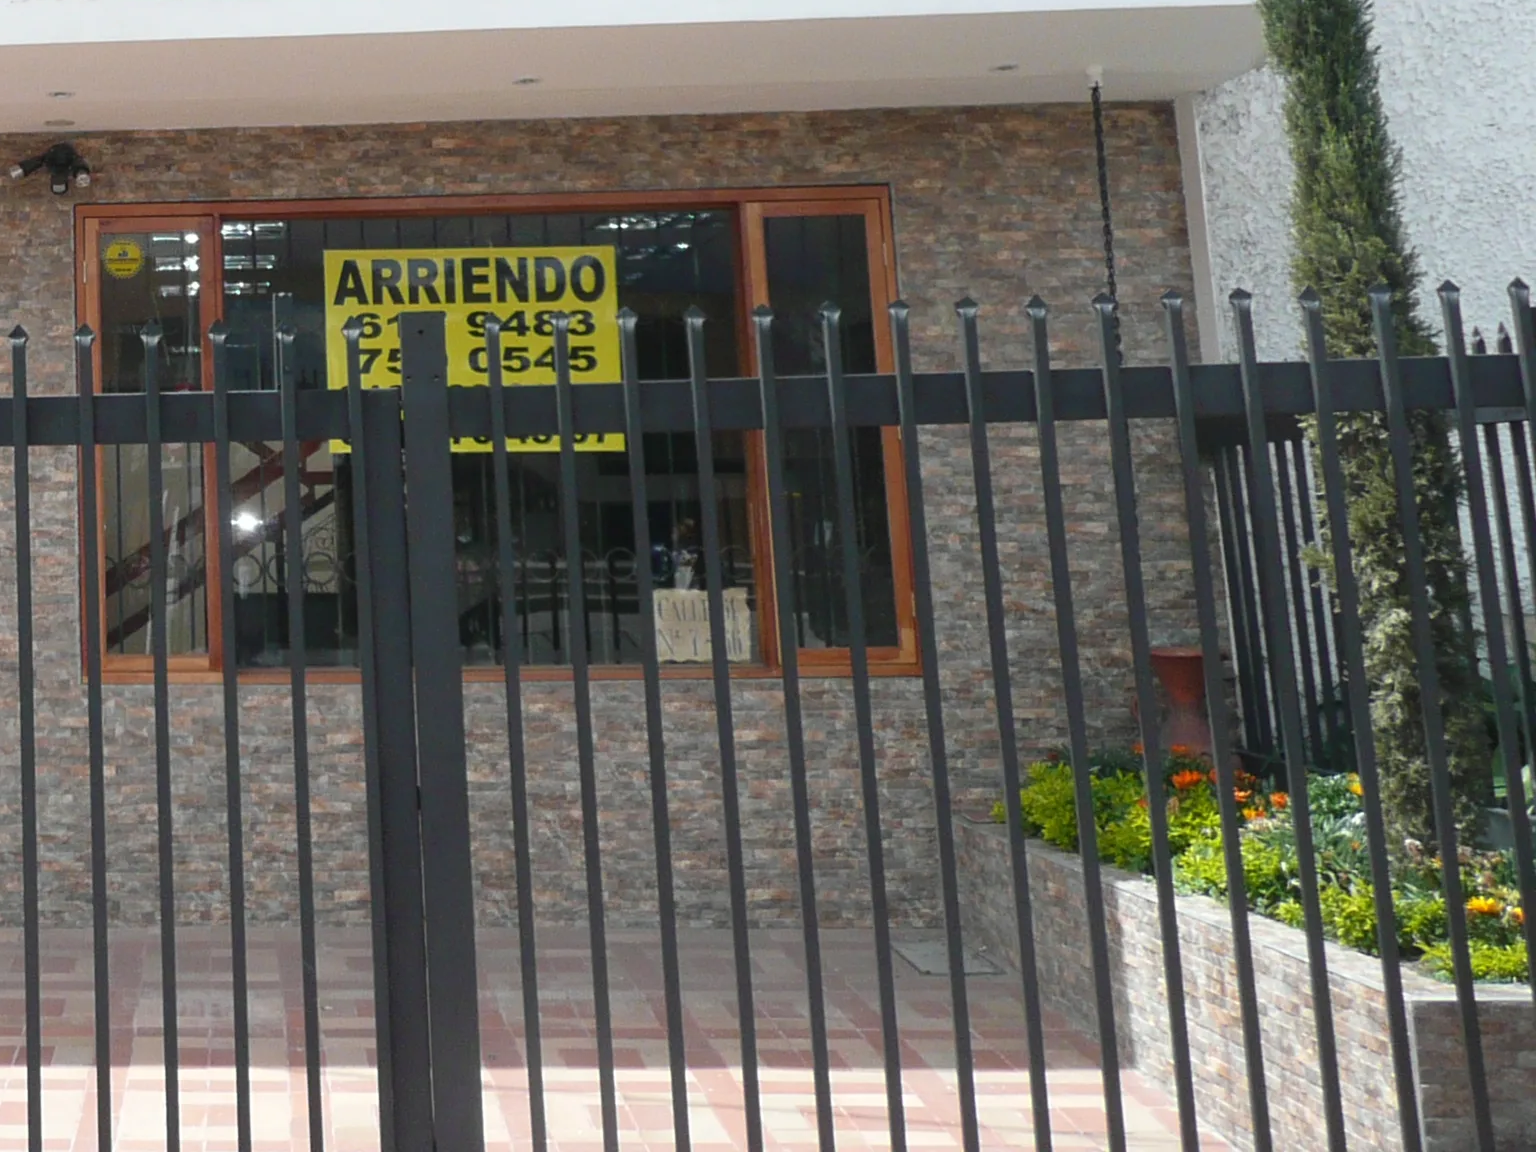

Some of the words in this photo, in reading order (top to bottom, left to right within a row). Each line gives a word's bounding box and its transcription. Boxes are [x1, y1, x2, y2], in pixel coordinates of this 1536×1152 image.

[333, 254, 607, 307] ARRIENDO
[353, 312, 403, 340] 61
[466, 309, 596, 338] 9483
[353, 348, 403, 375] 75
